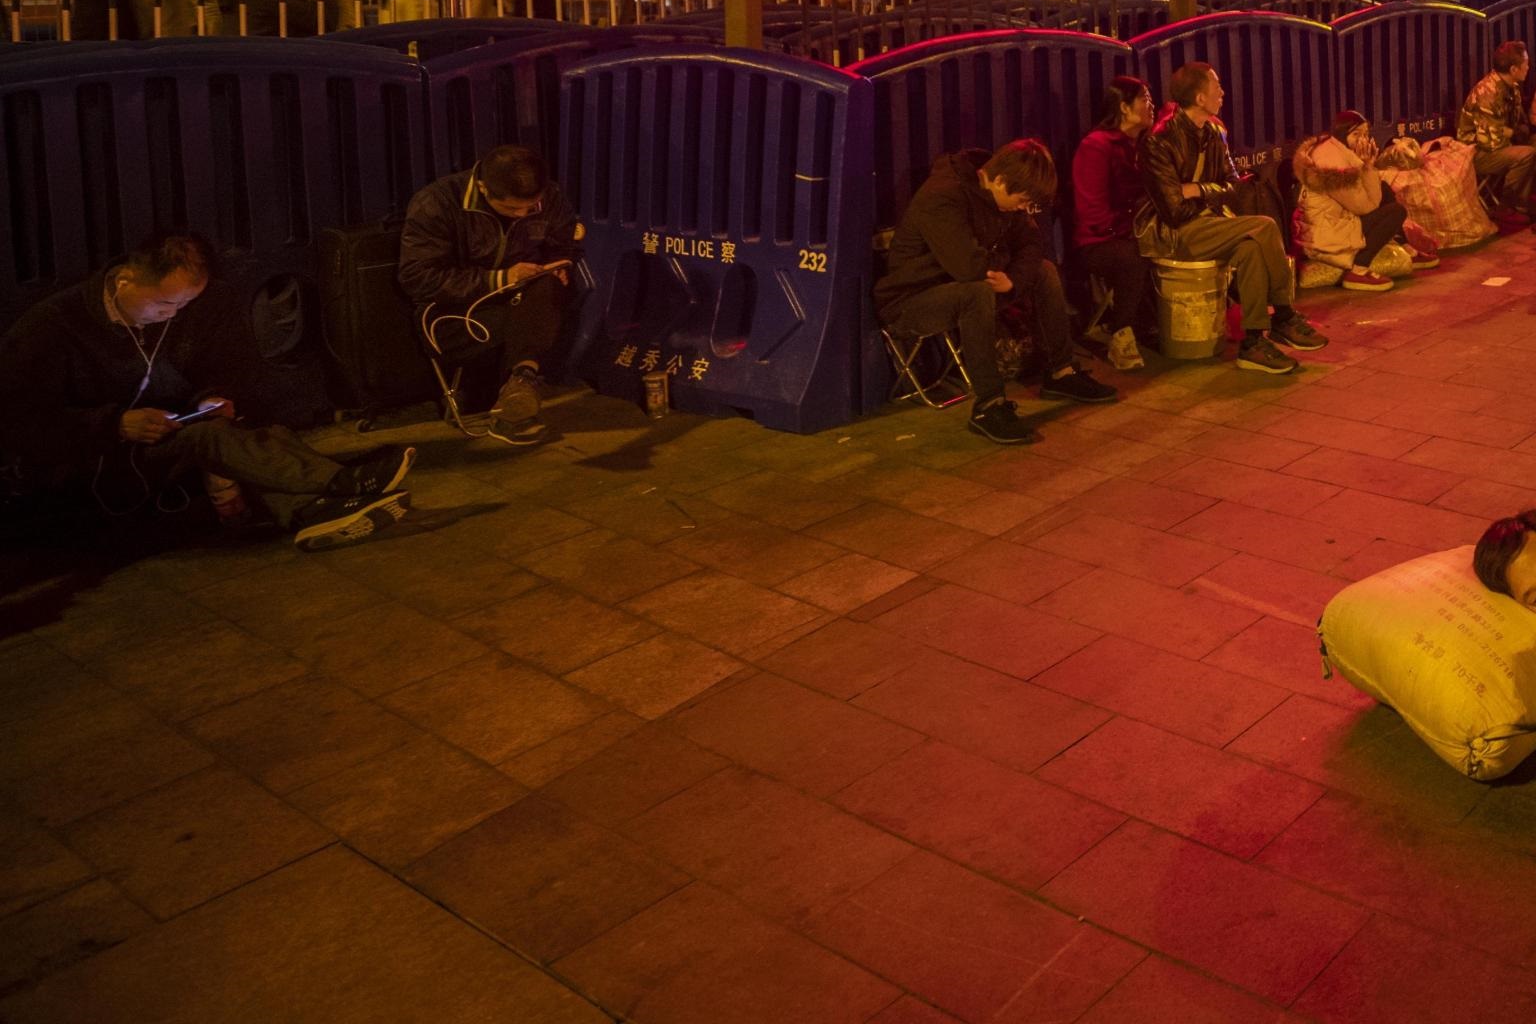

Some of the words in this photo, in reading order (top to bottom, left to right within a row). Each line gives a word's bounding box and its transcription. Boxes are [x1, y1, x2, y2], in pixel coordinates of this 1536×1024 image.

[641, 231, 660, 255] 警
[664, 235, 715, 260] POLICE
[720, 240, 737, 264] 察
[798, 248, 828, 274] 232
[613, 343, 712, 382] 越秀公安
